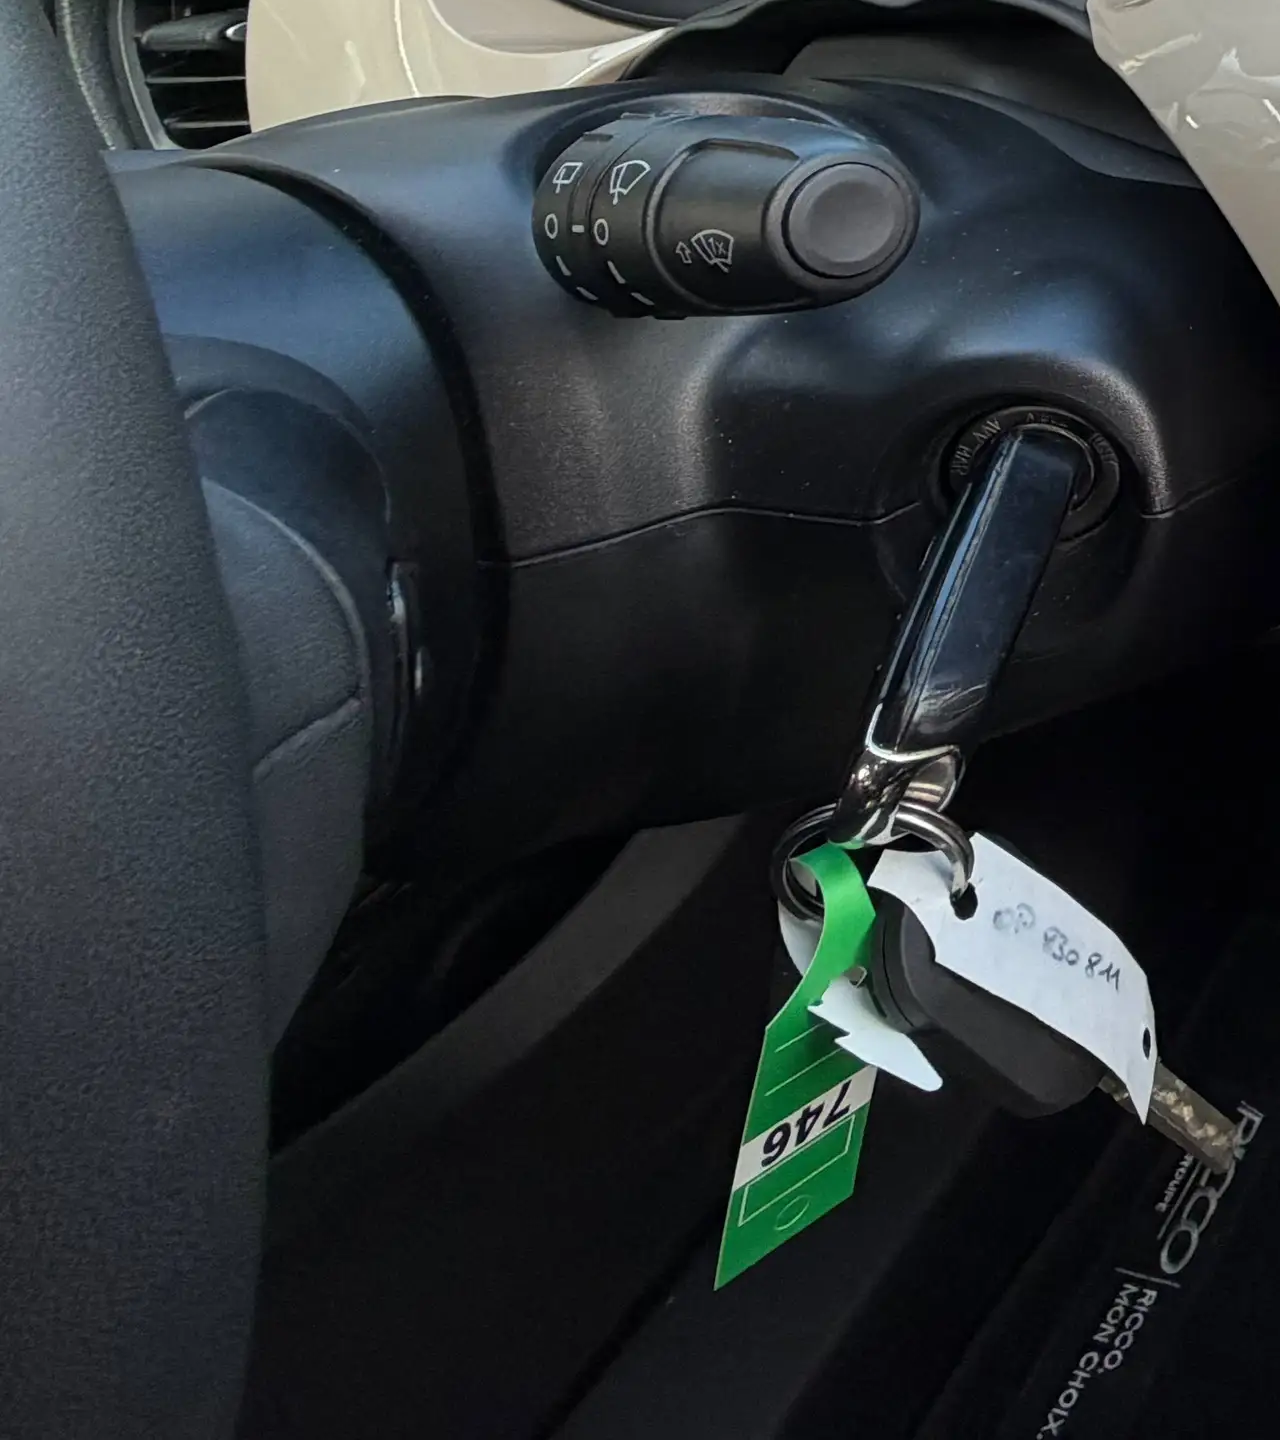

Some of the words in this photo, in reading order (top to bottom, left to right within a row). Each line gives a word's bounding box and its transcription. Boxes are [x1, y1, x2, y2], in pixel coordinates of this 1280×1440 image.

[761, 1079, 852, 1168] 746
[1092, 1283, 1139, 1343] MON
[1098, 1288, 1157, 1373] RICCO.
[1036, 1351, 1099, 1439] CHOIX.
